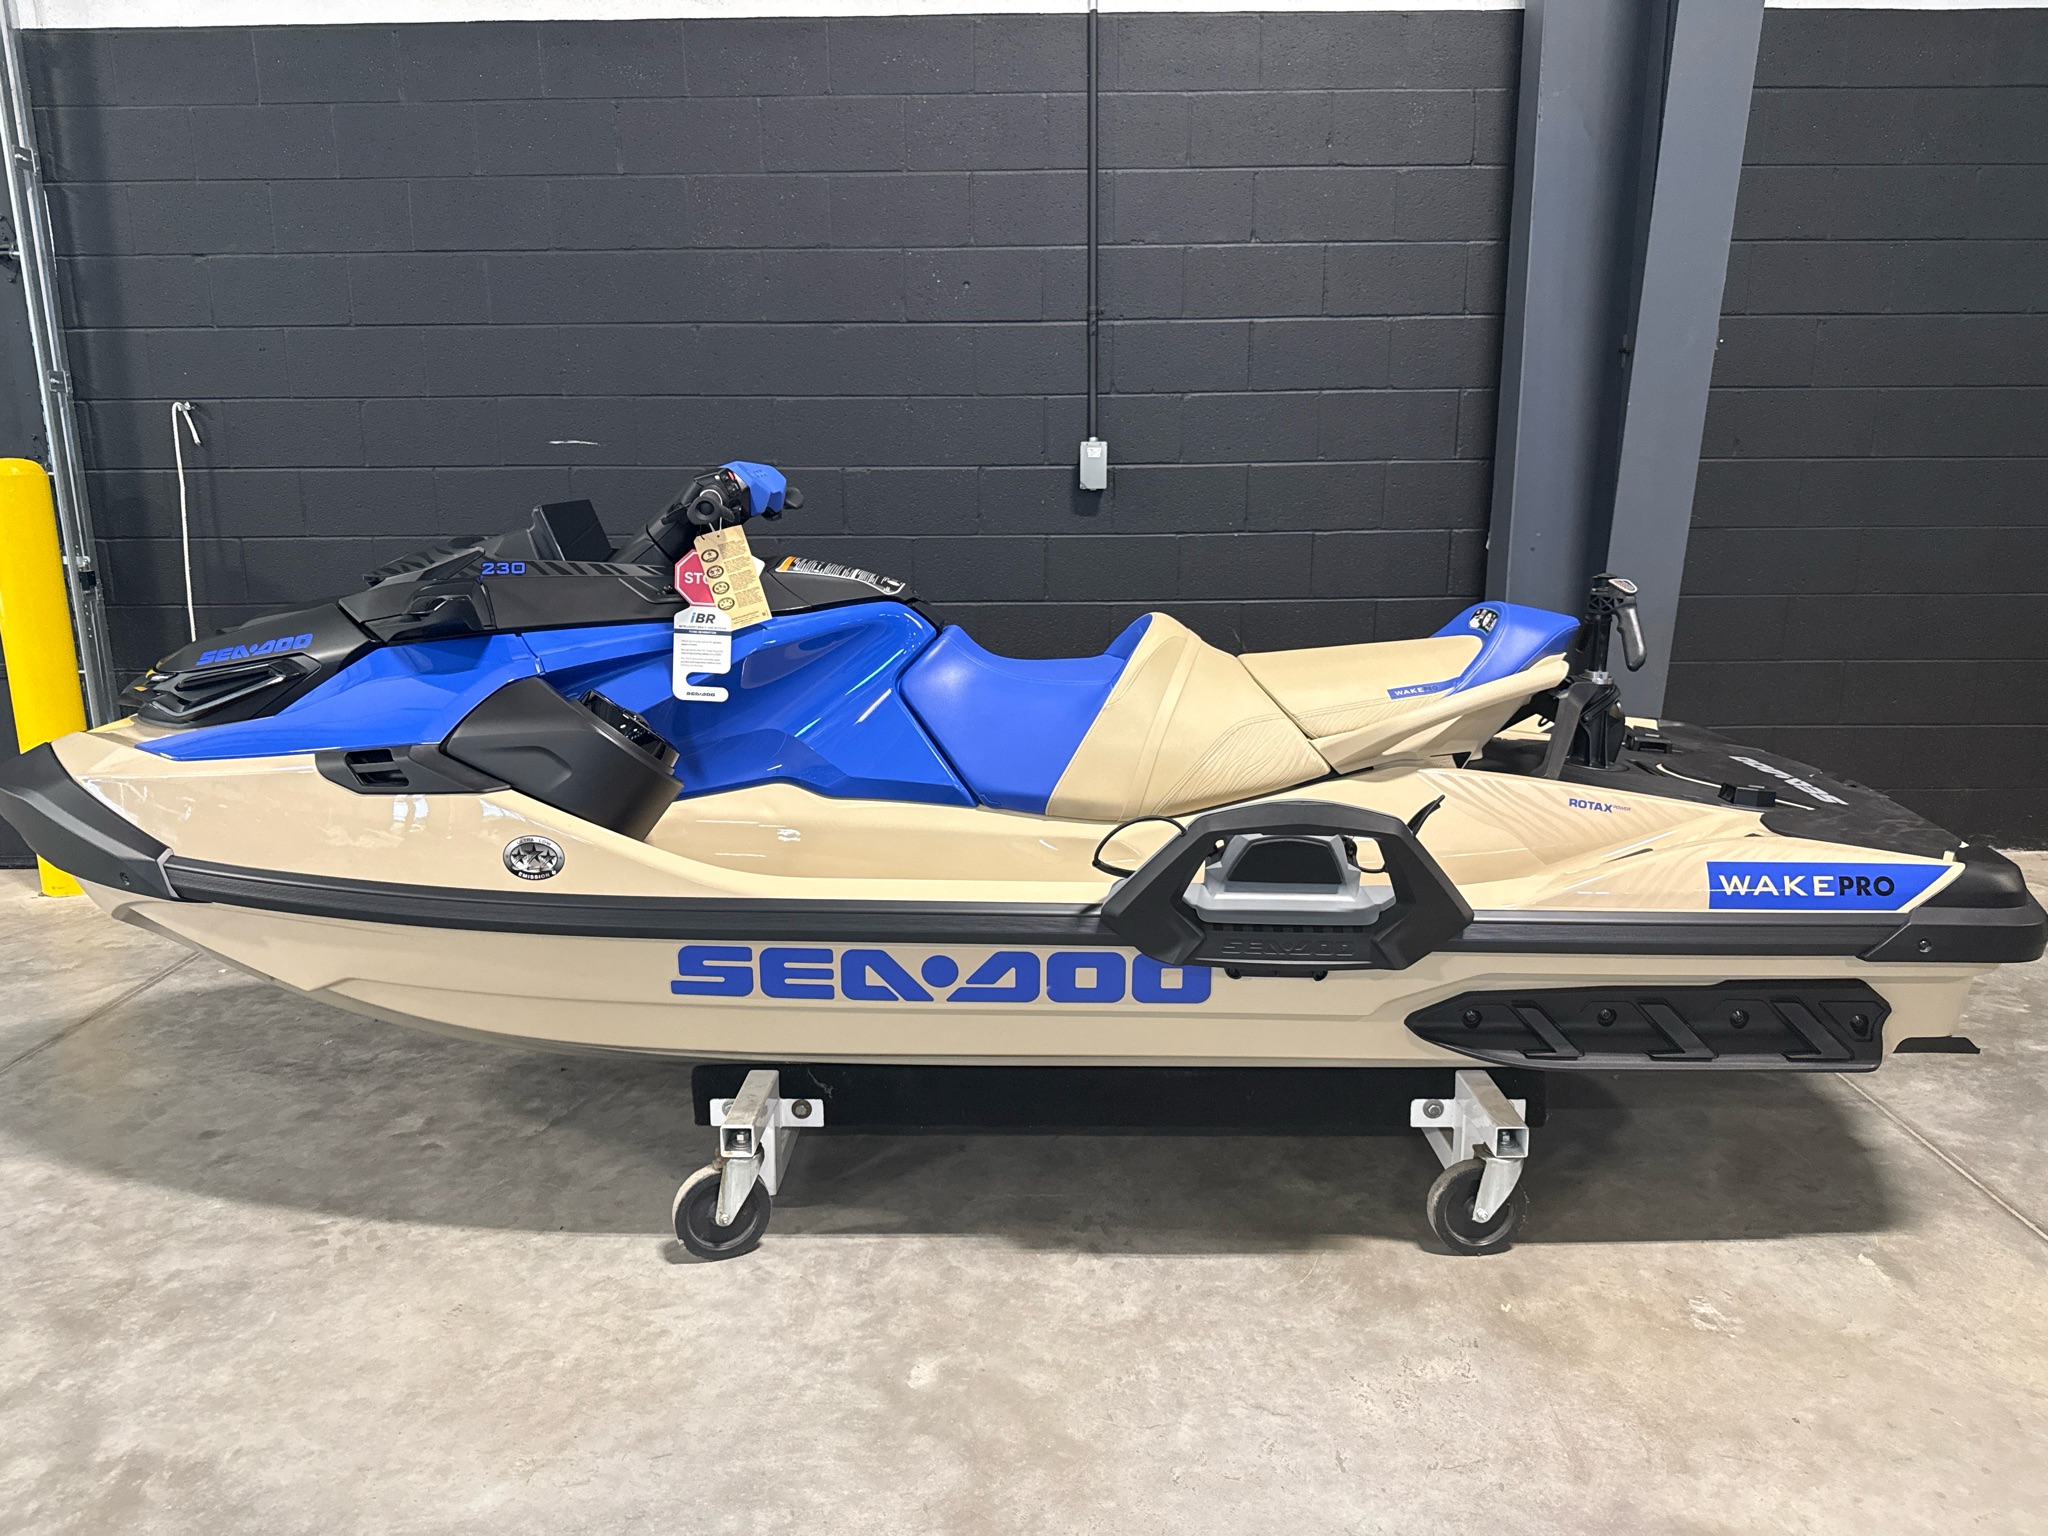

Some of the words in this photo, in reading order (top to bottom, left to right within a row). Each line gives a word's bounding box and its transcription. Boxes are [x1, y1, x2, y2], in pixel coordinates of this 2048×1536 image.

[481, 562, 526, 575] 230
[690, 612, 716, 624] iBR
[1569, 798, 1613, 813] ROTAX
